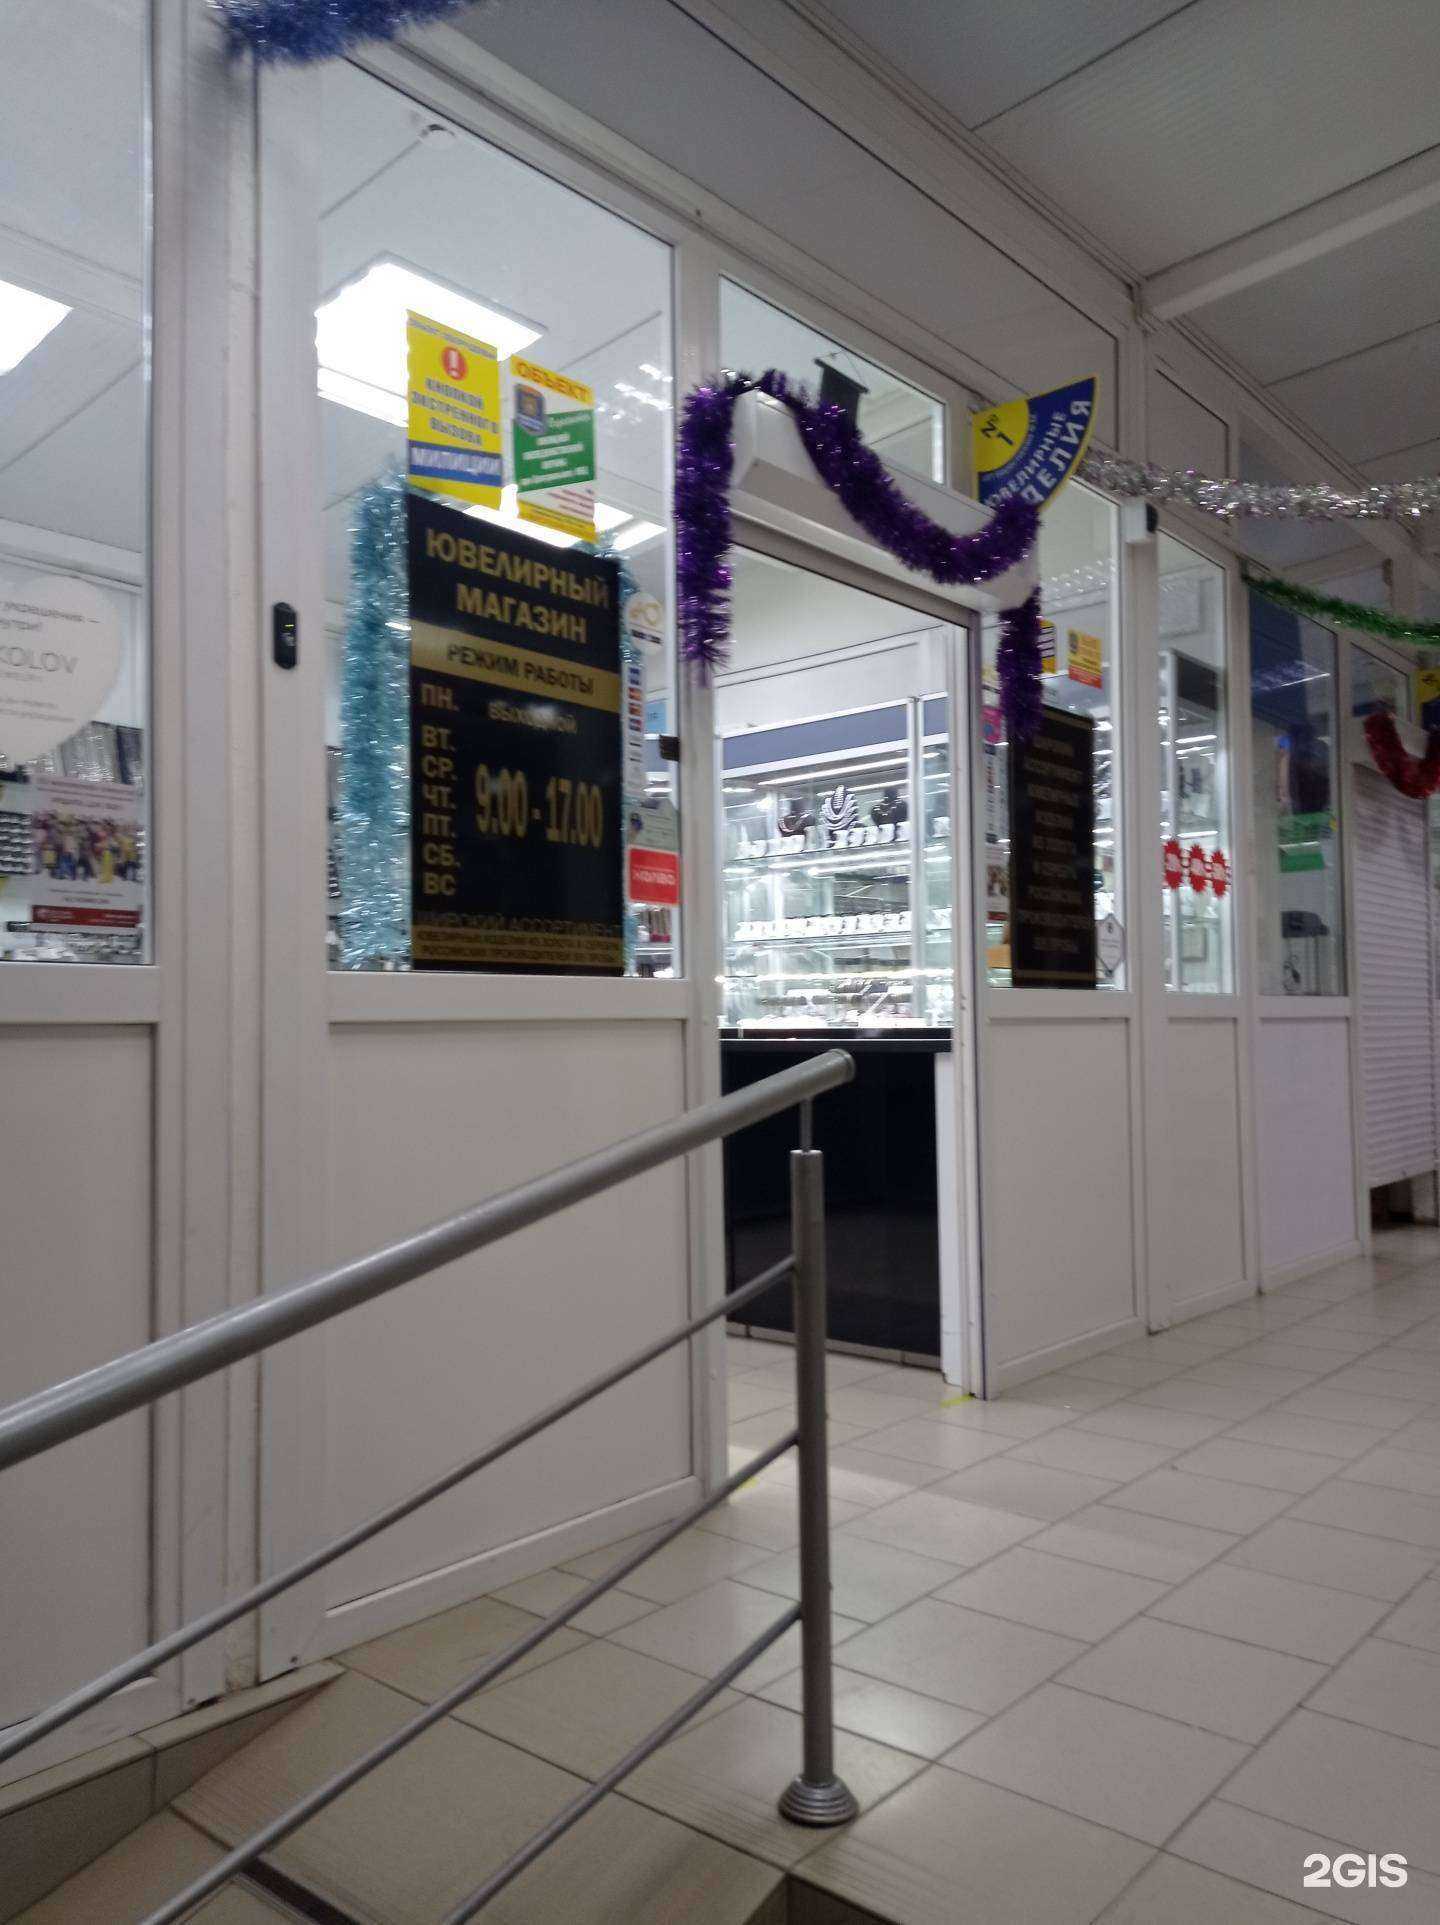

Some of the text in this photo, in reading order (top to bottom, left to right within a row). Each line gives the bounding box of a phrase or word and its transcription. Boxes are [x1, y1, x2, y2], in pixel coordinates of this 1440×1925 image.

[516, 361, 588, 402] ОБЪЕКТ
[411, 390, 499, 434] ЭКСТРЕННОГО
[429, 416, 482, 445] ВЫЗОВА
[1020, 400, 1092, 505] ДЕЛИЯ
[425, 528, 611, 609] ЮВЕЛИРНЫЙ
[456, 583, 587, 644] МАГАЗИН
[447, 643, 596, 696] РЕЖИМ РАБОТЫ
[420, 683, 459, 713] ПН.
[420, 724, 456, 751] ВТ.
[421, 755, 458, 781] СР.
[421, 783, 456, 809] ЧТ.
[422, 812, 458, 839] ПТ.
[545, 776, 603, 848] 17.00
[423, 842, 461, 868] СБ.
[423, 872, 456, 896] ВС
